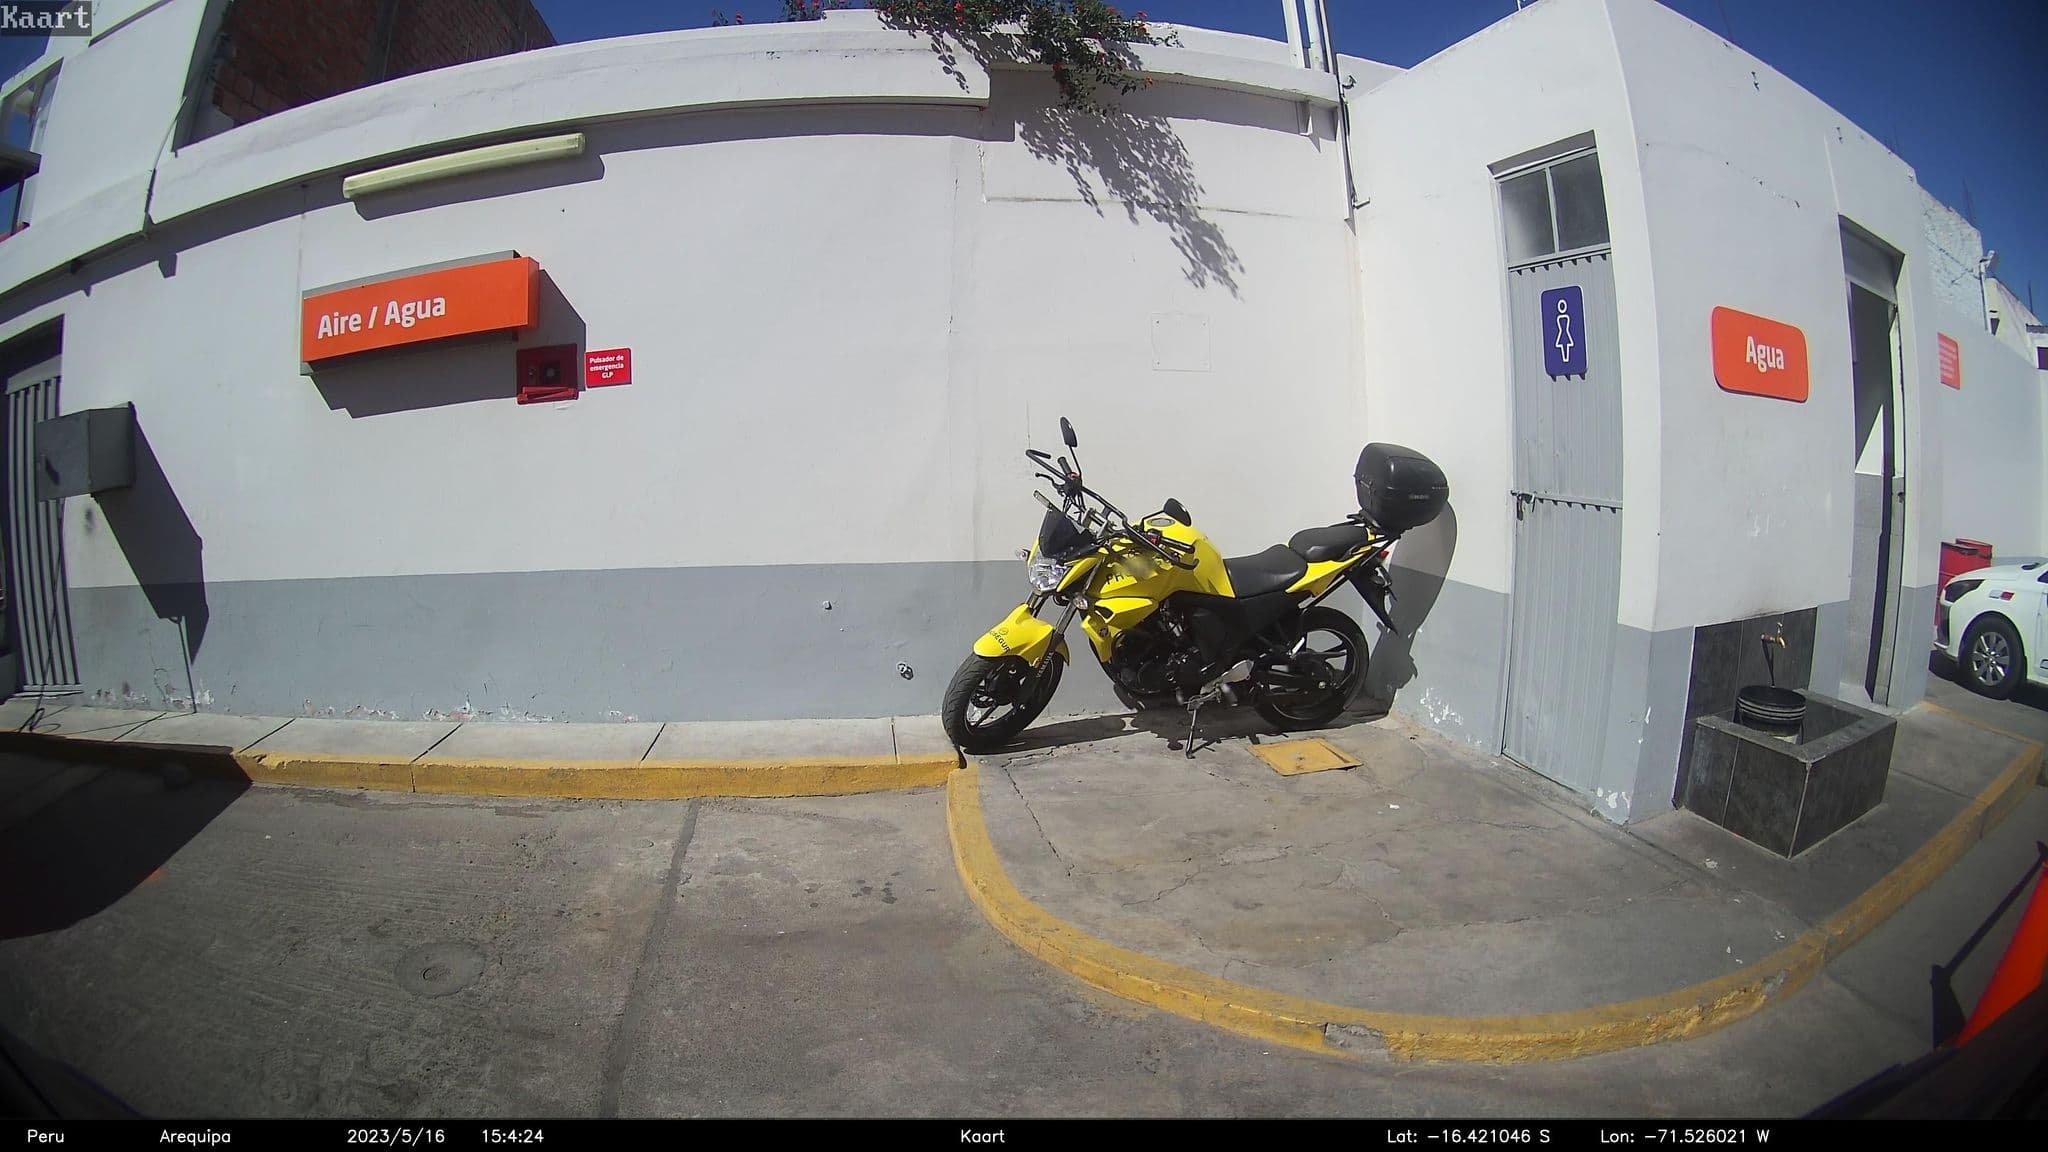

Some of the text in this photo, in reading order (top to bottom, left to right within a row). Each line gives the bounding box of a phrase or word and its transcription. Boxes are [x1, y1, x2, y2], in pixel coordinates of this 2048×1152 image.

[317, 296, 446, 339] Aire / Agua
[1745, 335, 1785, 373] Agua
[589, 356, 615, 364] Pulsador
[589, 362, 625, 372] emergencia
[601, 371, 614, 379] GLP
